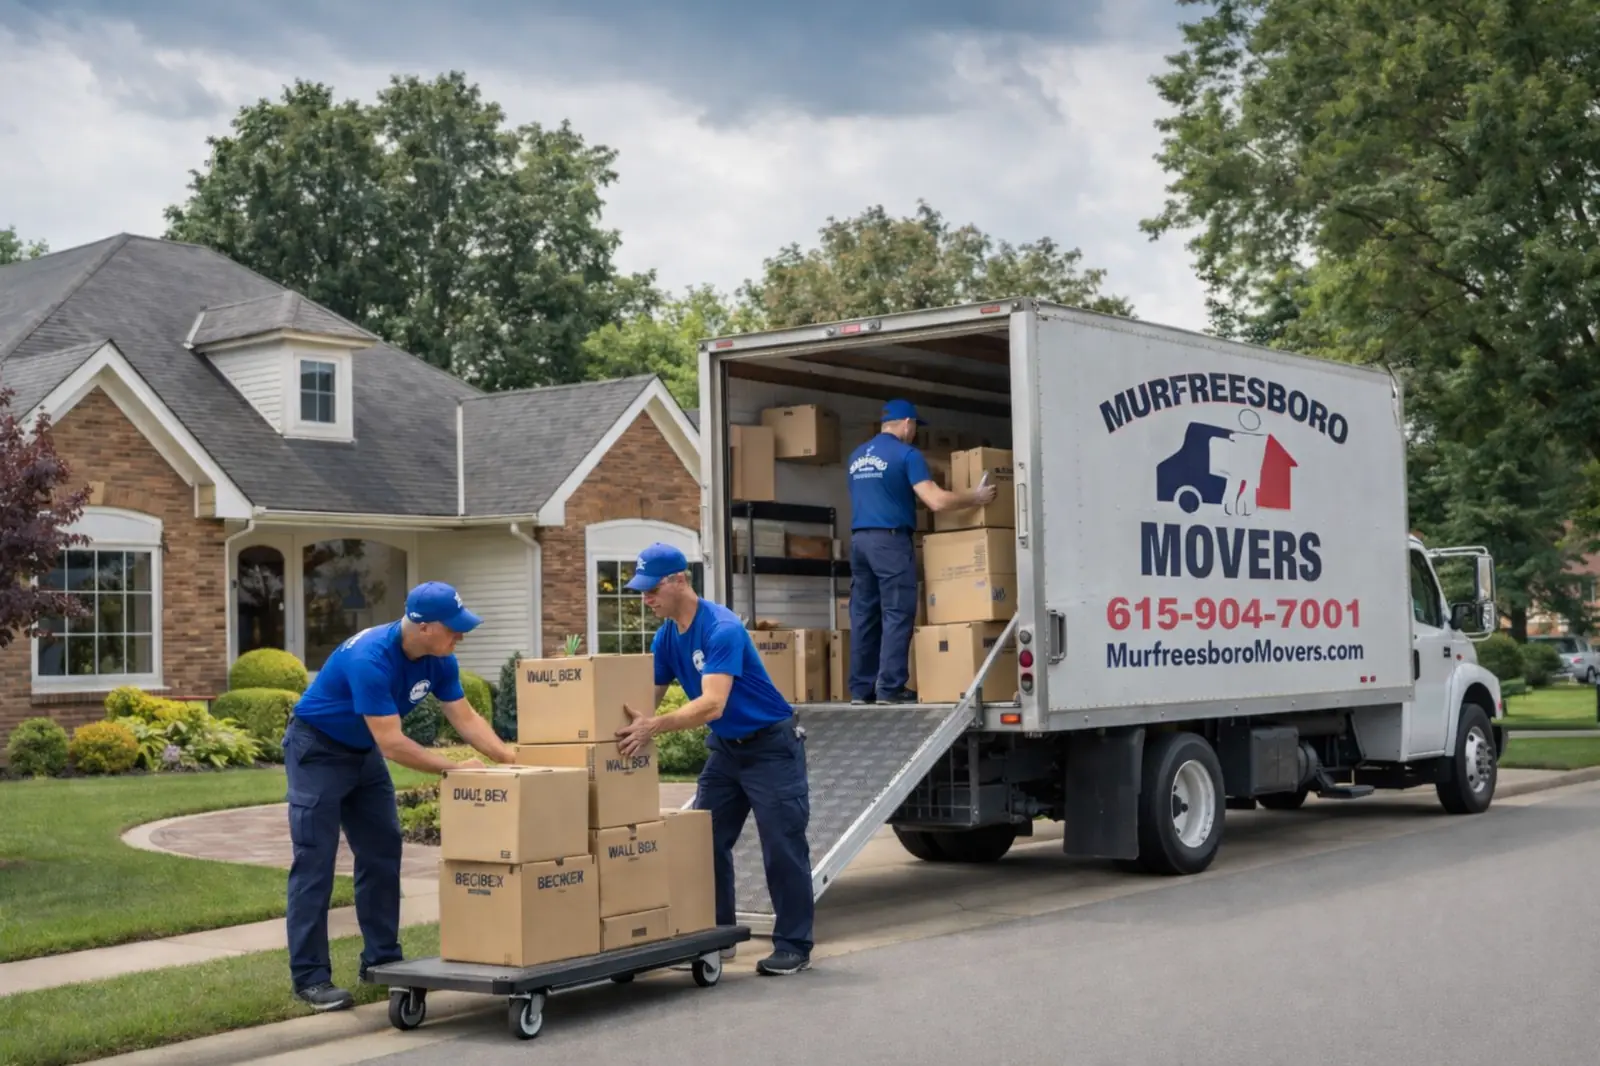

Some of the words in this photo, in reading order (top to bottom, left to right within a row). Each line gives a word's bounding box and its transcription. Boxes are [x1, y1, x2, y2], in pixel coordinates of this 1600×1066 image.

[1099, 372, 1349, 445] MURFREESBORO
[1140, 521, 1322, 582] MOVERS
[1106, 596, 1361, 631] 615-904-7001
[1106, 639, 1365, 668] MurfreesboroMovers.com
